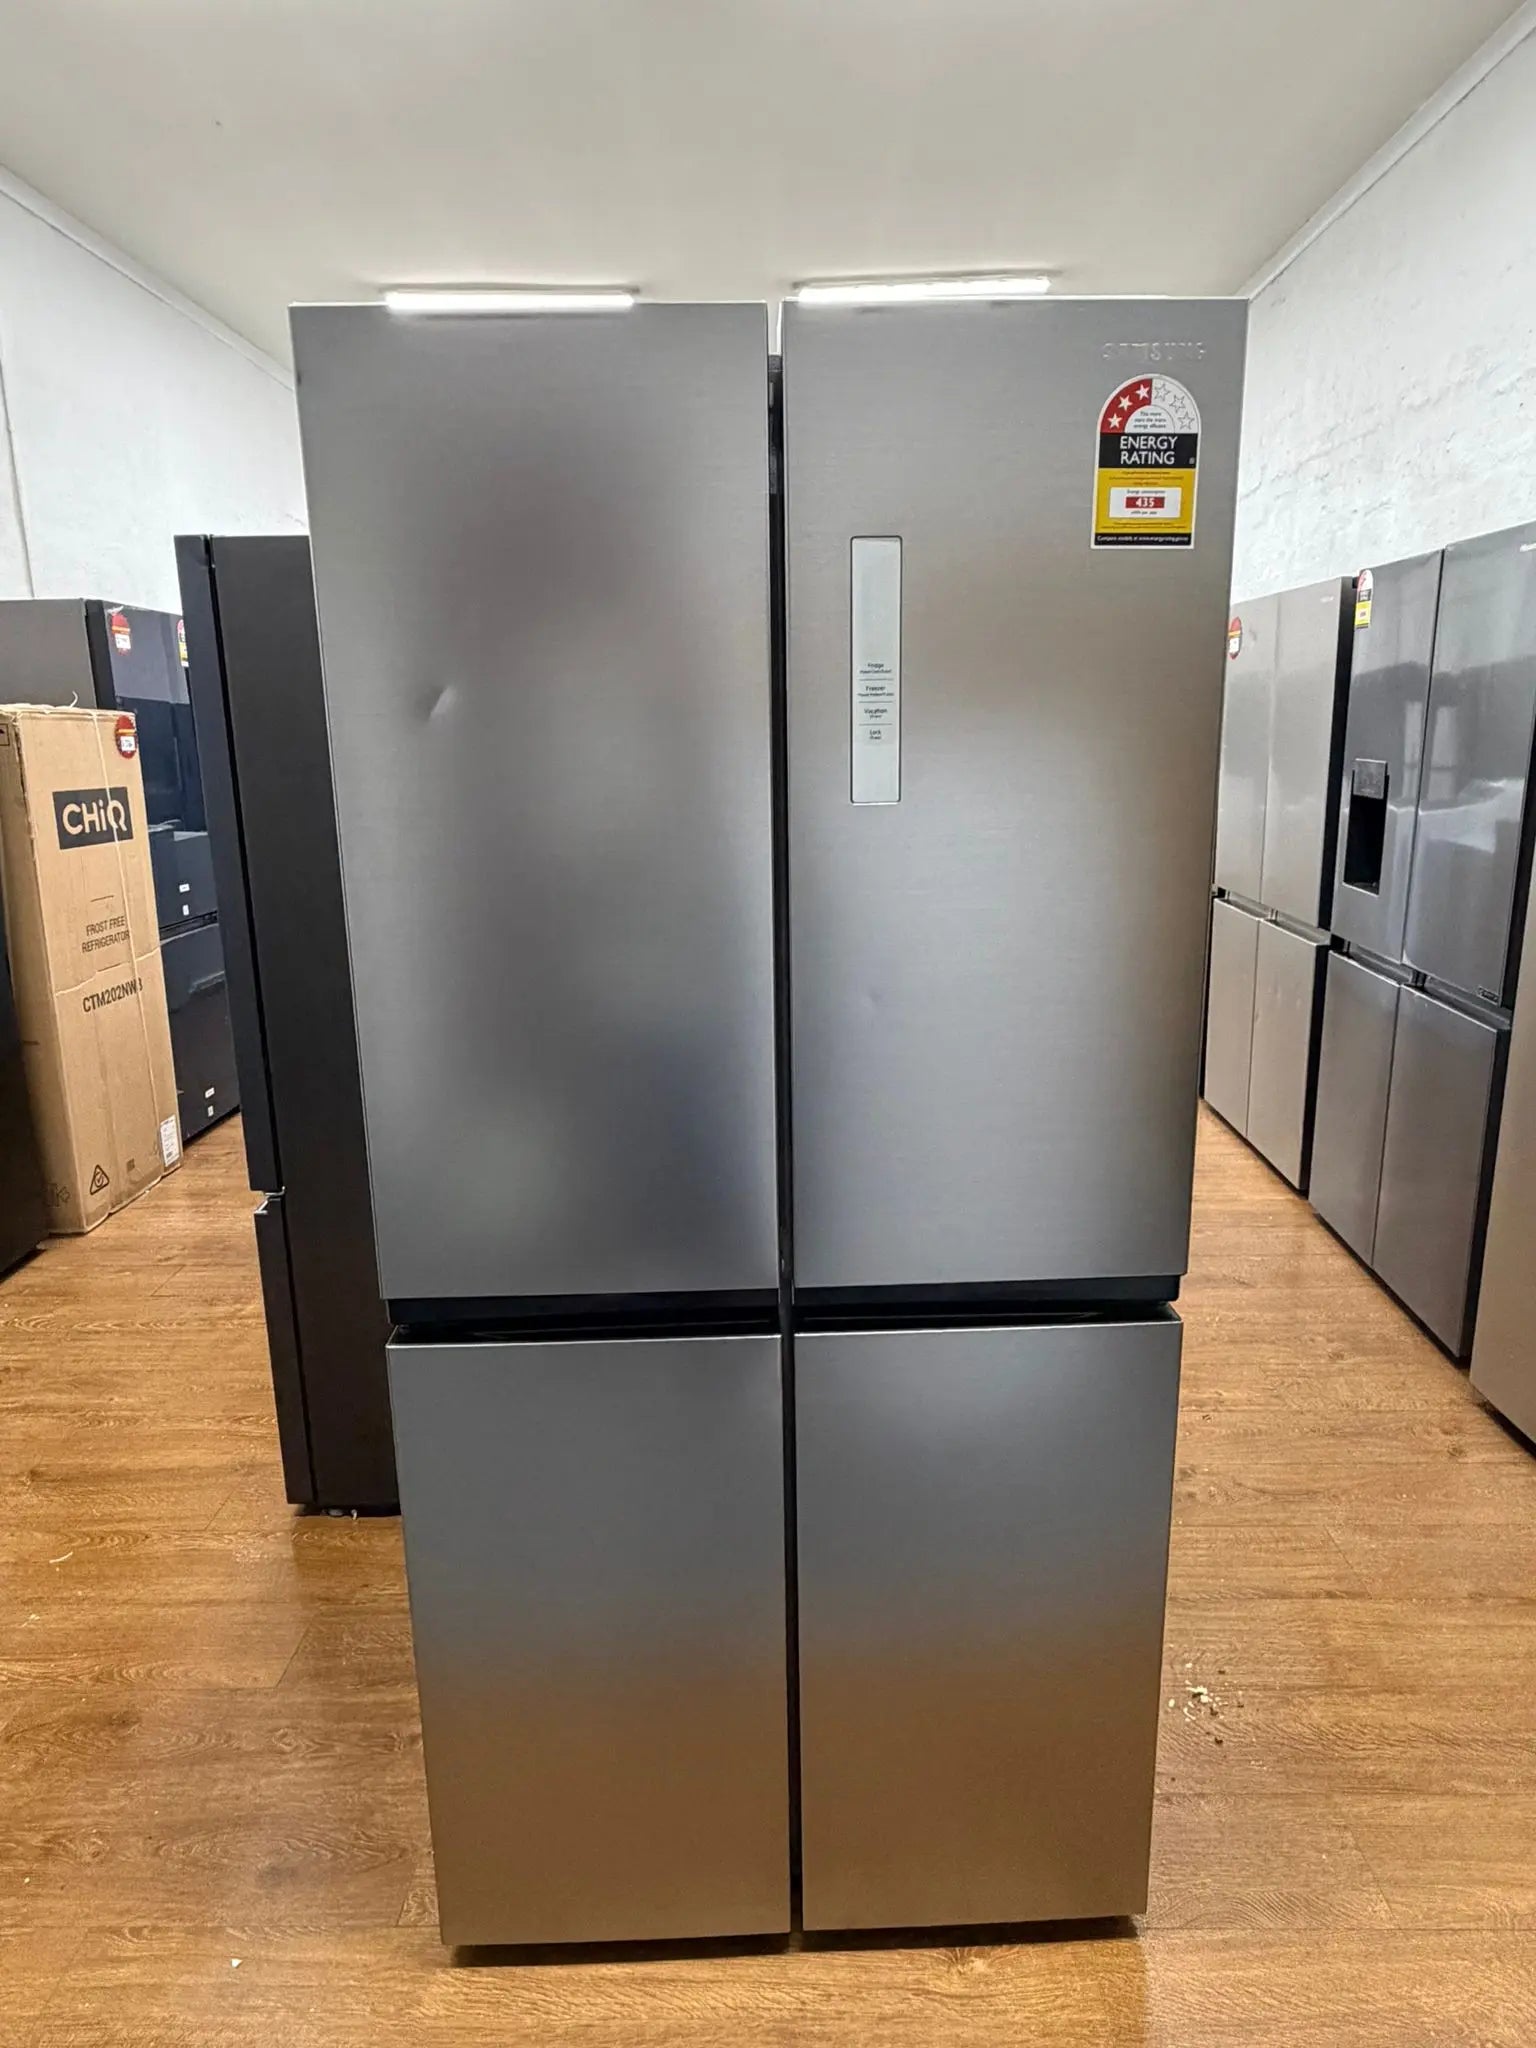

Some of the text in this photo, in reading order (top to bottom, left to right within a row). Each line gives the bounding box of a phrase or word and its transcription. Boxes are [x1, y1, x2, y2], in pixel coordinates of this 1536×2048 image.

[1120, 436, 1178, 450] ENERGY
[1120, 451, 1175, 465] RATING
[1135, 497, 1155, 507] 435
[62, 799, 128, 835] CHiQ
[86, 915, 125, 937] FROST FREE
[81, 929, 131, 954] REFRIGERATOR
